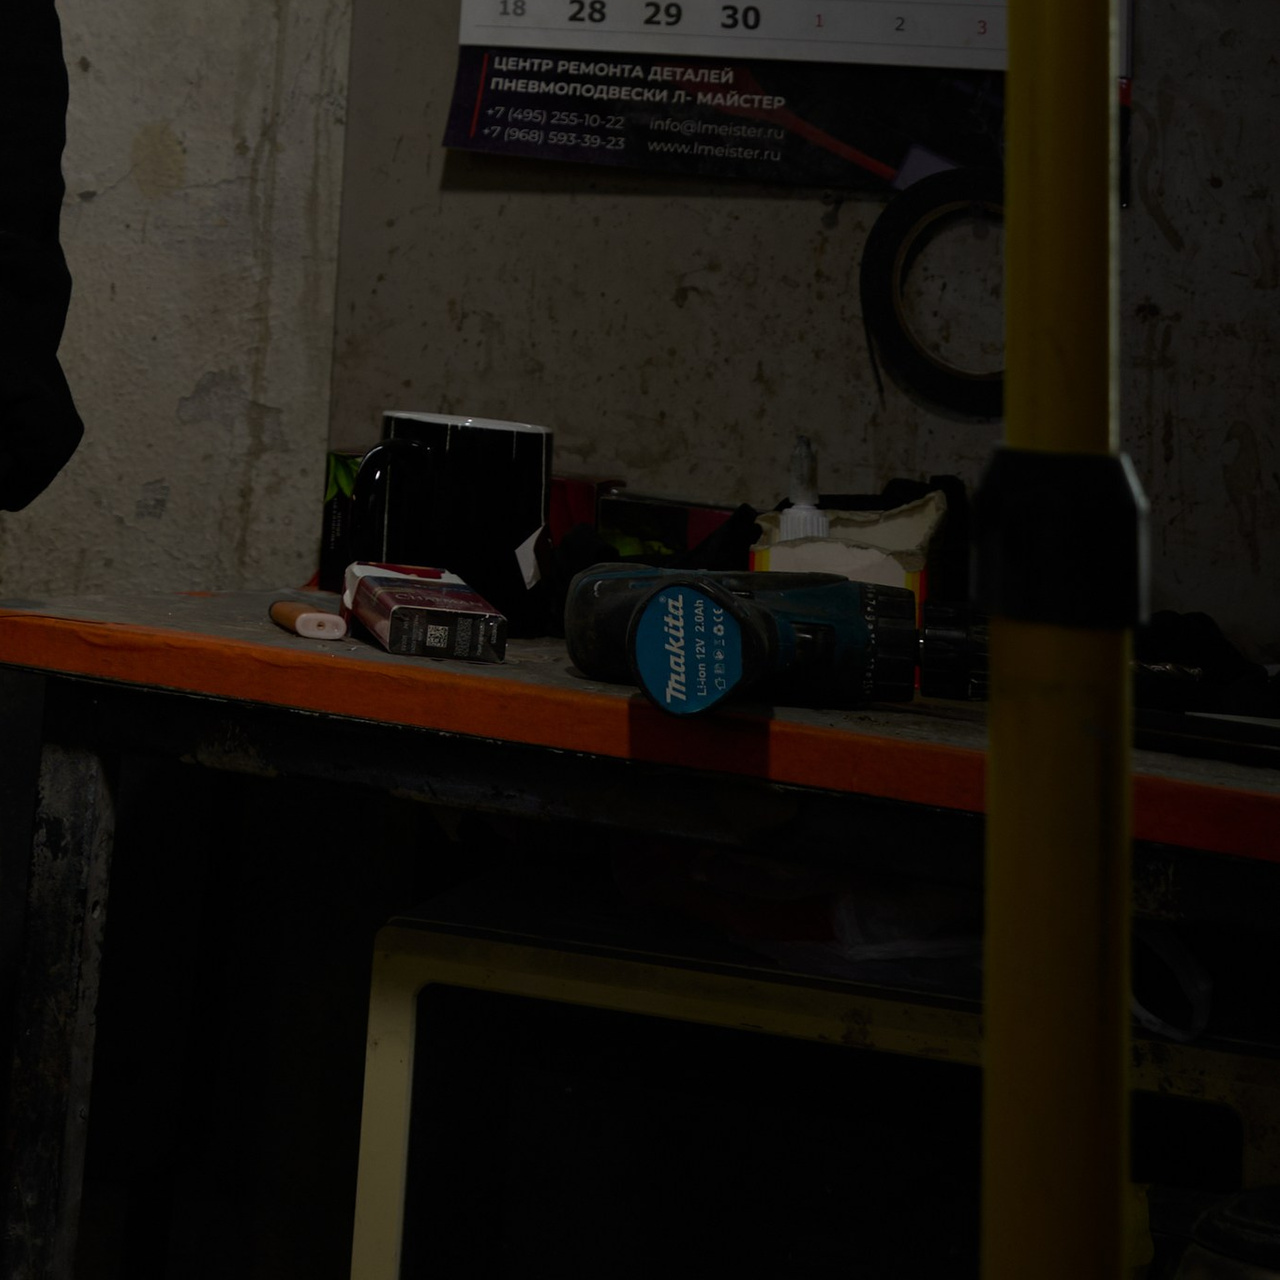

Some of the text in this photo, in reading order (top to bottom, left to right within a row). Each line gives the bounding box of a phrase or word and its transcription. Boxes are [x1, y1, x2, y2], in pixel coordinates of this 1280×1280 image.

[499, 0, 987, 35] 18 28 29 30 1 2 3
[494, 56, 733, 84] ЦЕНТР РЕМОНТА ДЕТАЛЕЙ
[490, 77, 668, 102] ПНЕВМОПОДВЕСКИ
[697, 91, 785, 109] МАЙСТЕР
[486, 106, 625, 129] +7 (495) 255-10-22
[649, 117, 785, 141] info@lmeister.ru
[482, 126, 626, 150] +7 (968) 593-39-23
[647, 139, 781, 162] www.lmeister.ru
[694, 600, 707, 696] Li-ion 12V 2.0Ah
